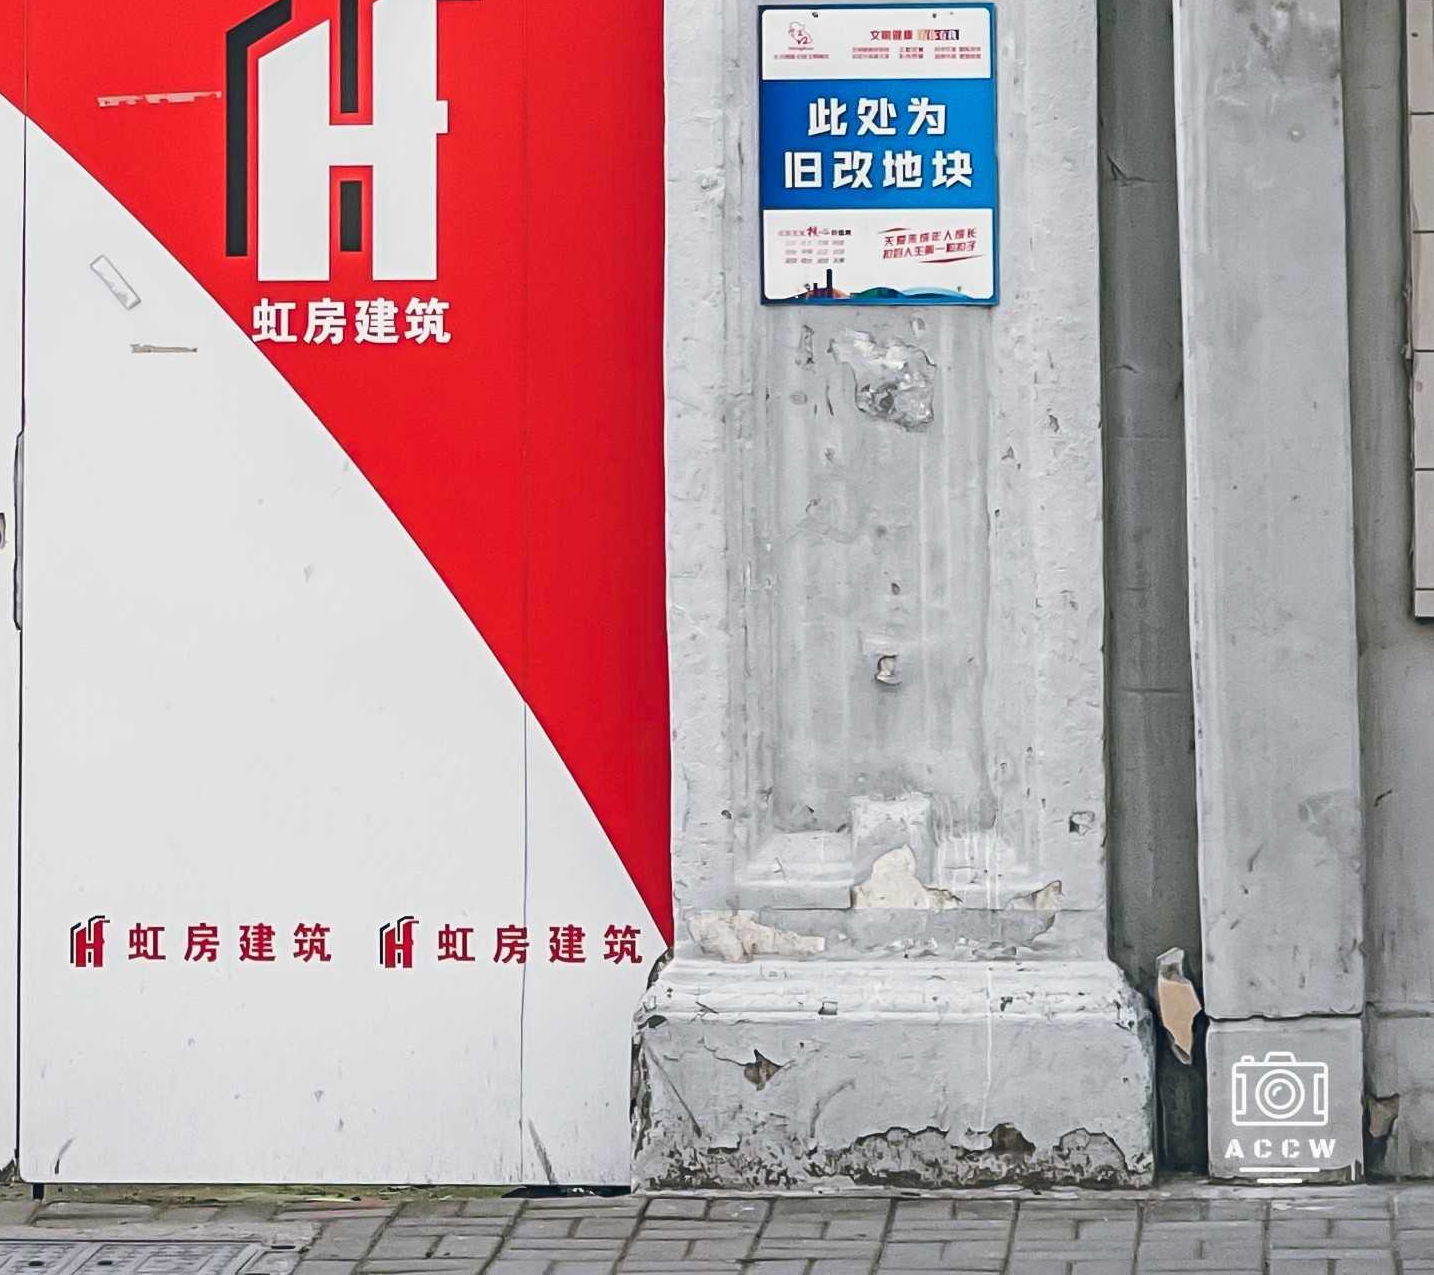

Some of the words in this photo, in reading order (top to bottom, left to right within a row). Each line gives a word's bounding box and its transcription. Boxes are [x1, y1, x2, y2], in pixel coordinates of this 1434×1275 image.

[808, 97, 946, 136] 此处为
[784, 150, 973, 189] 旧改地块
[251, 297, 452, 344] 虹房建筑
[128, 922, 332, 963] 虹房建筑
[437, 924, 643, 964] 虹房建筑
